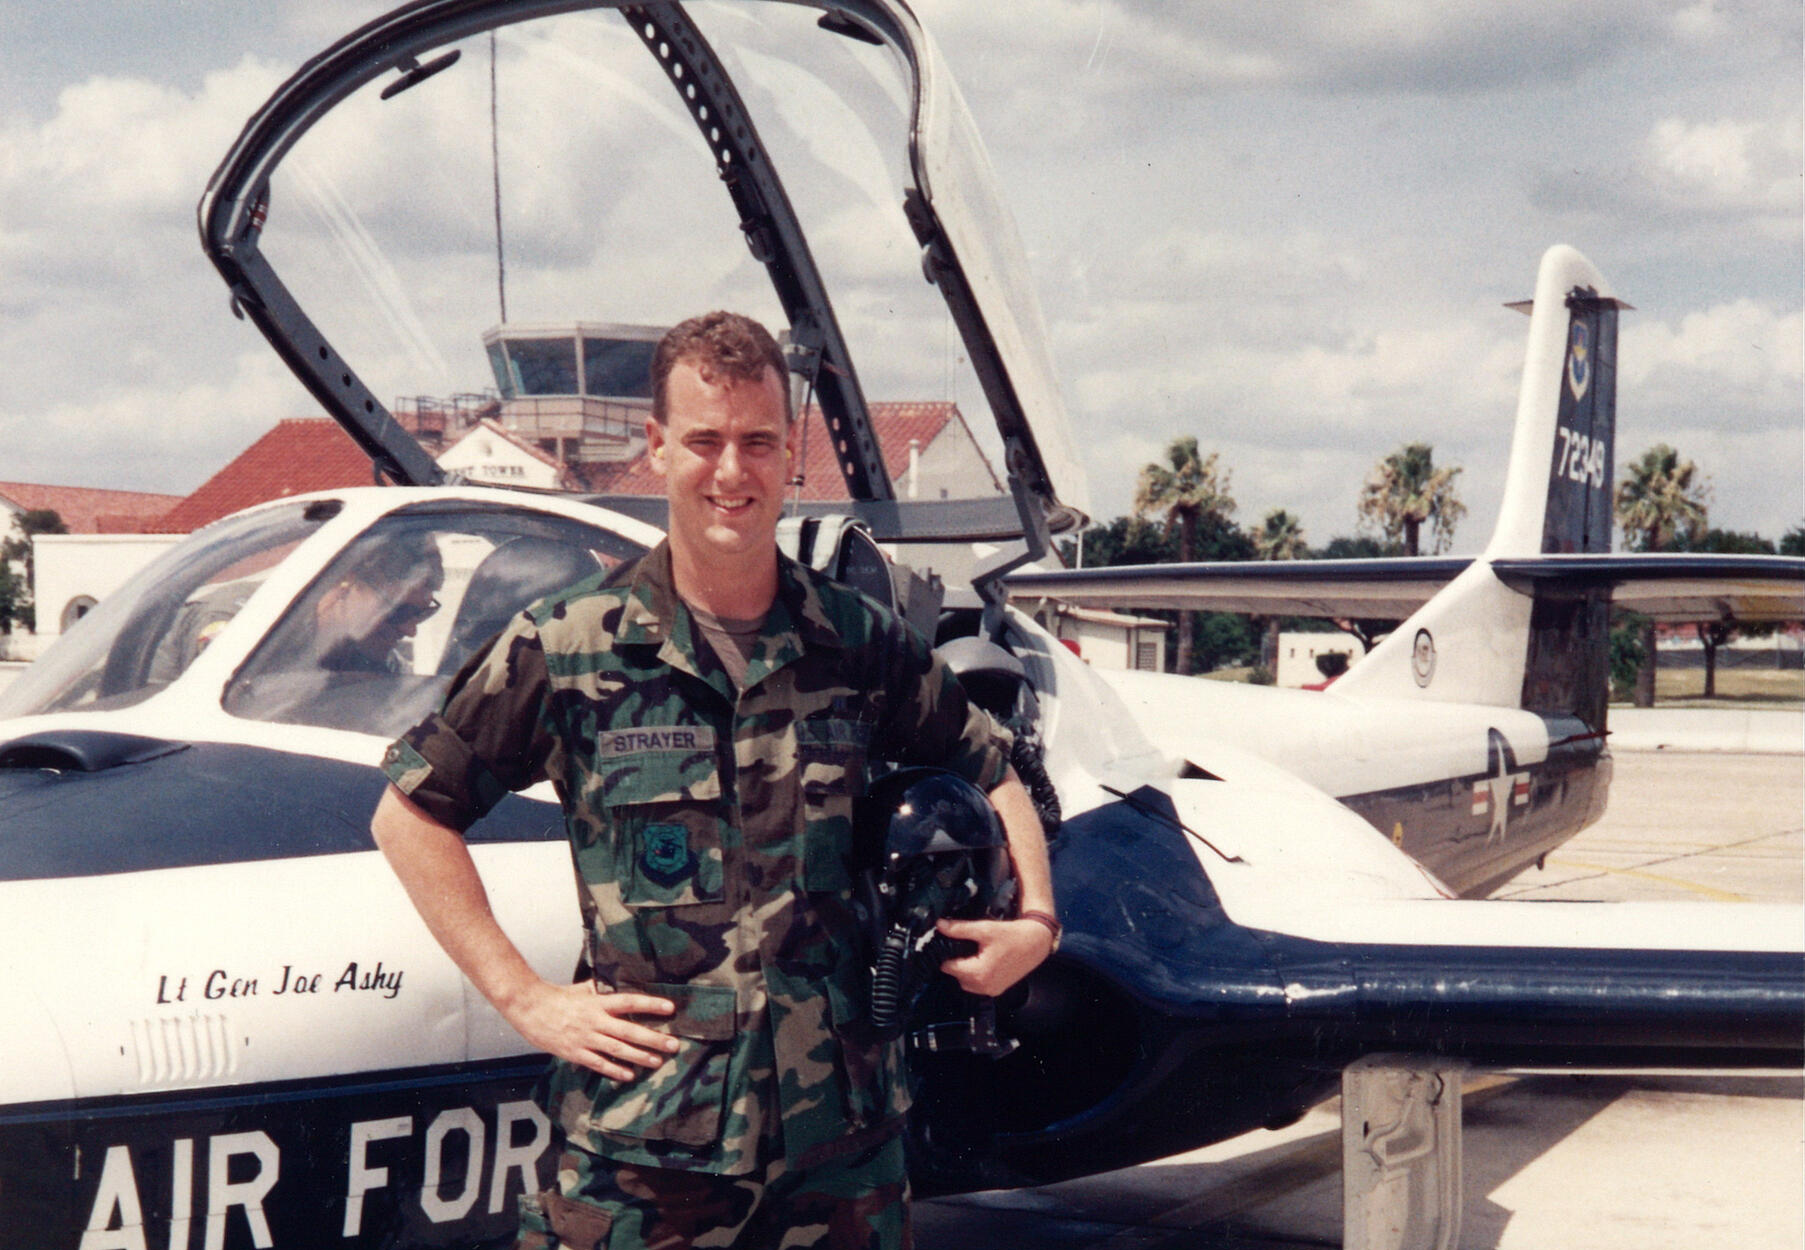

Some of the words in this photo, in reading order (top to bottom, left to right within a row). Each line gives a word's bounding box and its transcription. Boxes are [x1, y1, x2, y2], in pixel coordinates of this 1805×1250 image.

[614, 732, 695, 752] STRAYER
[157, 975, 187, 1004] Lt
[203, 969, 258, 1000] Gen
[272, 965, 323, 995] Joe
[334, 961, 404, 999] Ashy
[342, 1100, 552, 1238] FOR
